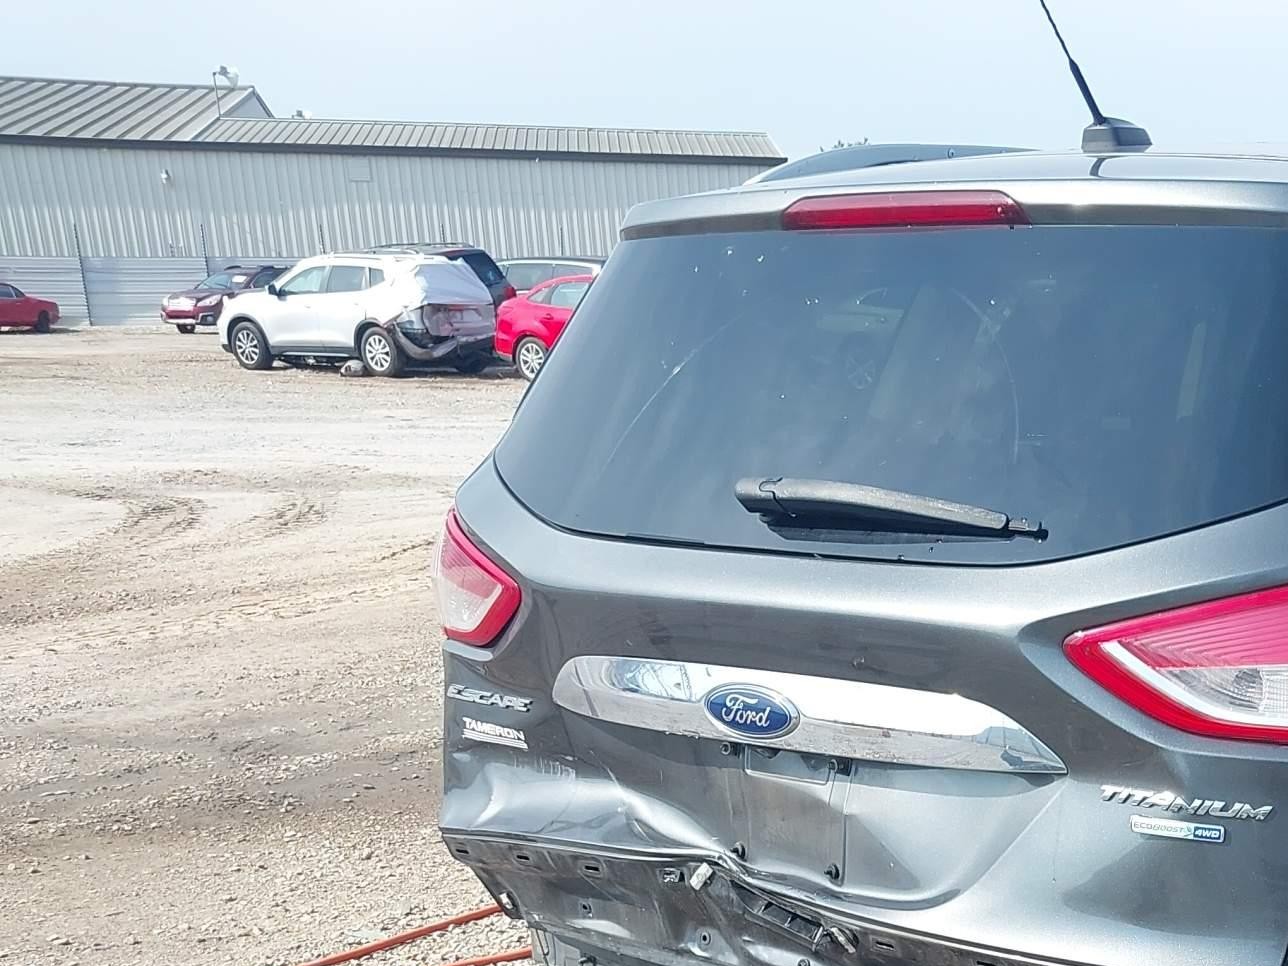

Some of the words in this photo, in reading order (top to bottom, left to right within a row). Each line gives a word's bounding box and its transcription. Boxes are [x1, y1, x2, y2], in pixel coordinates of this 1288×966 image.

[447, 683, 534, 713] ESCAPE
[722, 693, 771, 728] Ford
[462, 716, 526, 741] TAMERON
[1099, 784, 1274, 822] TITANIUM
[1194, 827, 1221, 839] 4WD
